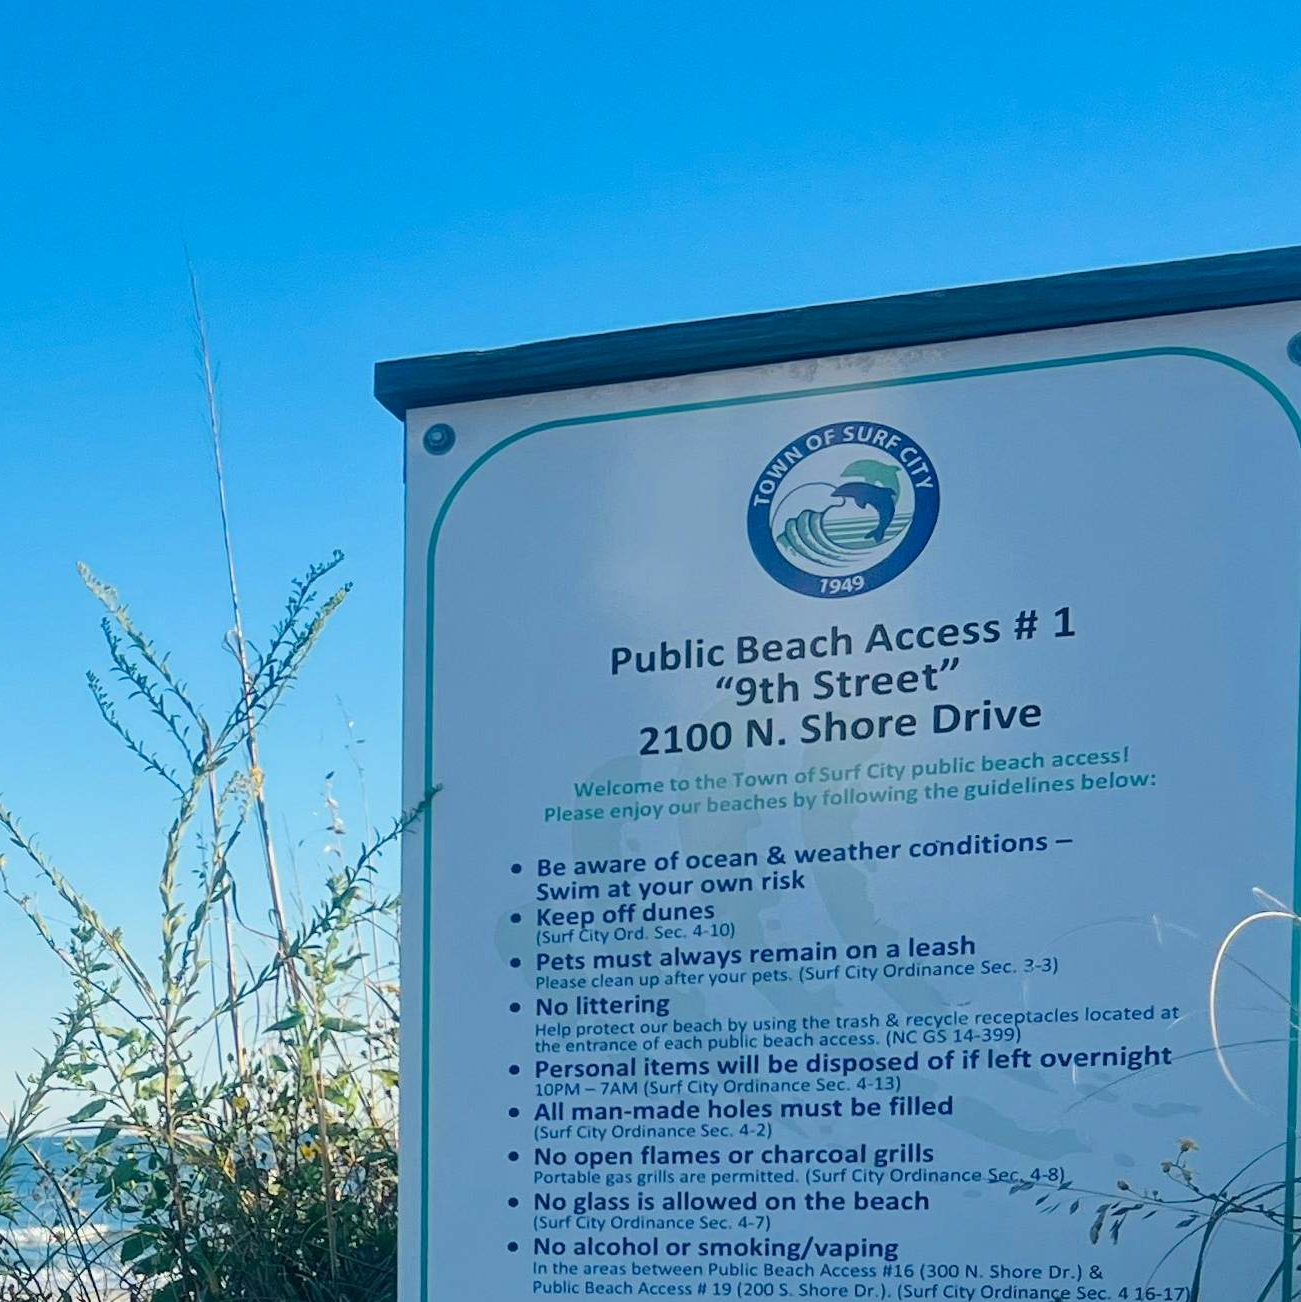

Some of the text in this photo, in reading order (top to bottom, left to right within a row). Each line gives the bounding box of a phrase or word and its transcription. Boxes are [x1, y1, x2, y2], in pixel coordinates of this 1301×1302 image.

[753, 426, 935, 507] TOWN OF SURF CITY
[819, 575, 866, 594] 1949
[611, 606, 1076, 676] Public Beach Access # 1
[639, 699, 1042, 756] 2100 N. Shore Drive
[573, 779, 665, 798] Welcome
[669, 778, 690, 792] to
[694, 773, 727, 790] the
[732, 771, 788, 788] Town
[794, 766, 816, 784] of
[819, 763, 862, 783] Surf
[867, 762, 906, 782] City
[911, 756, 975, 781] public
[981, 751, 1045, 772] beach
[544, 771, 1157, 823] Please enjoy our beaches by following the guidelines below:
[537, 858, 566, 877] Be
[573, 857, 647, 875] aware
[654, 850, 680, 871] of
[685, 852, 758, 870] ocean
[766, 845, 787, 866] &
[794, 840, 902, 864] weather
[908, 833, 1048, 858] conditions
[535, 869, 806, 902] Swim at your own risk
[536, 902, 715, 933] Keep off dunes
[536, 921, 736, 947] (Surf City Ord. Sec. 4-10)
[536, 934, 976, 973] Pets must always remain on a leash
[535, 956, 1059, 990] Please clean up after your pets. (Surf City Ordinance Sec. 3-3)
[535, 994, 671, 1018] No littering
[535, 1004, 1180, 1042] Help protect our beach by using the trash & recycle receptacles located at
[535, 1044, 1173, 1079] Personal items will be disposed of if left overnight
[535, 1082, 581, 1097] 10PM
[599, 1081, 639, 1096] 7AM
[643, 1079, 684, 1098] (Surf
[687, 1080, 719, 1097] City
[723, 1078, 811, 1094] Ordinance
[815, 1074, 851, 1092] Sec.
[856, 1075, 902, 1093] 4-13)
[533, 1095, 954, 1122] All man-made holes must be filled
[534, 1142, 934, 1171] No open flames or charcoal grills
[534, 1170, 601, 1185] Portable
[606, 1173, 632, 1188] gas
[637, 1169, 675, 1187] grills
[680, 1172, 706, 1184] are
[711, 1168, 799, 1186] permitted.
[805, 1167, 846, 1186] (Surf
[852, 1167, 884, 1186] City
[890, 1167, 982, 1183] Ordinance
[1030, 1166, 1065, 1187] 4-8)
[534, 1190, 930, 1217] No glass is allowed on the beach
[533, 1235, 900, 1262] No alcohol or smoking/vaping
